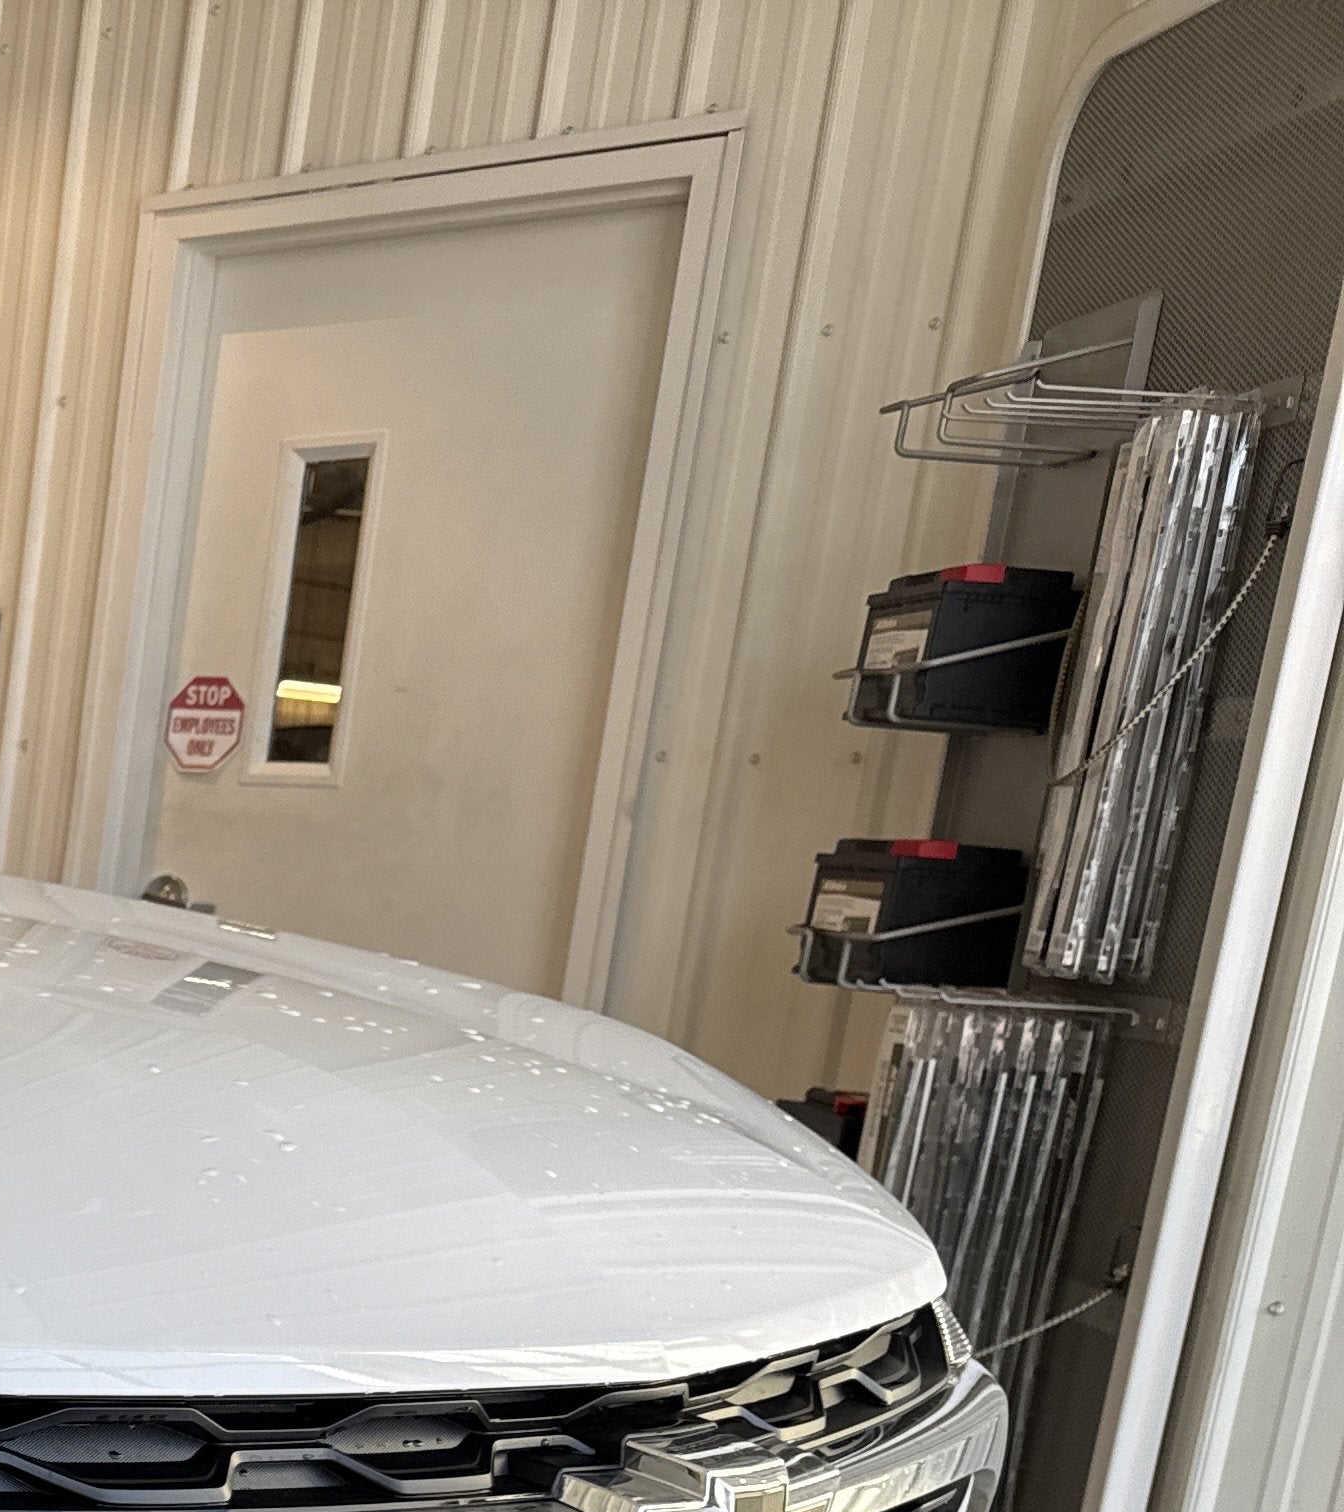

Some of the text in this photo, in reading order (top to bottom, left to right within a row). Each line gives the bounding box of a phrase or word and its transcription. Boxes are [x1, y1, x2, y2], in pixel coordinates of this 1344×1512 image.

[185, 685, 232, 706] STOP
[172, 716, 235, 736] EMPLOYEES
[186, 739, 216, 757] ONLY
